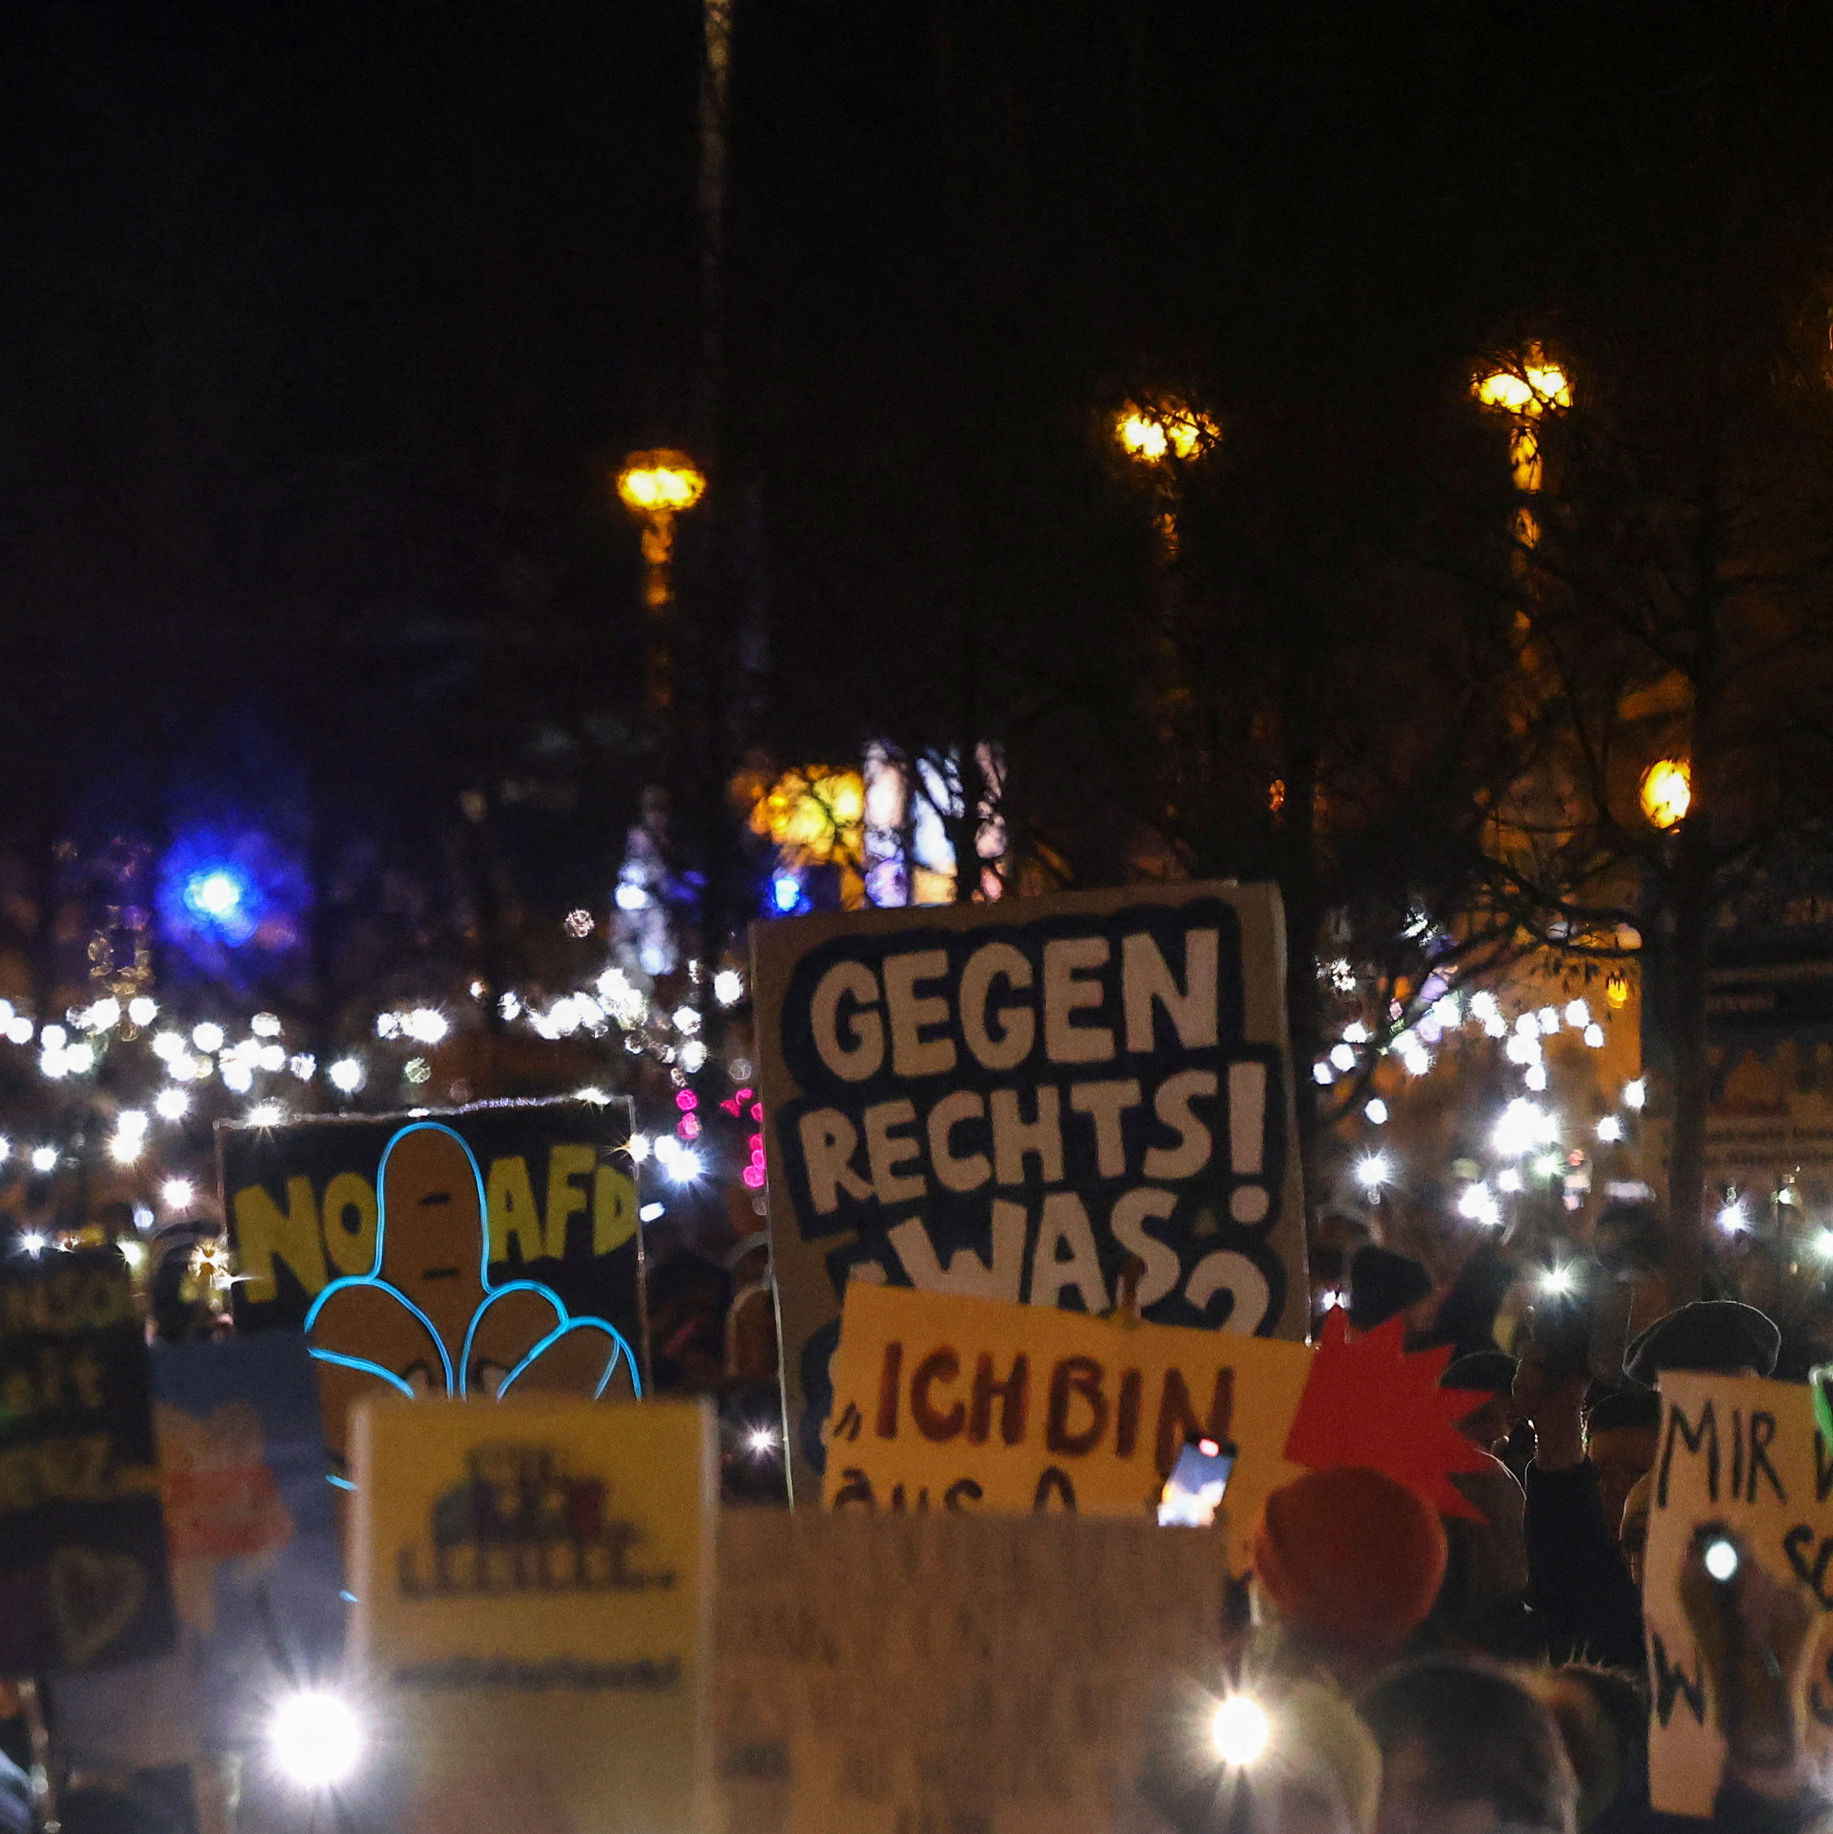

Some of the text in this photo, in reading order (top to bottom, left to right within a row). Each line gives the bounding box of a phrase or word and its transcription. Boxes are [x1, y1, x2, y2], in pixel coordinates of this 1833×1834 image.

[808, 927, 1221, 1082] GEGEN
[796, 1060, 1272, 1226] RECHTS!
[233, 1144, 639, 1303] NO AFD
[1065, 1354, 1236, 1478] BIN
[1656, 1398, 1788, 1509] MIR
